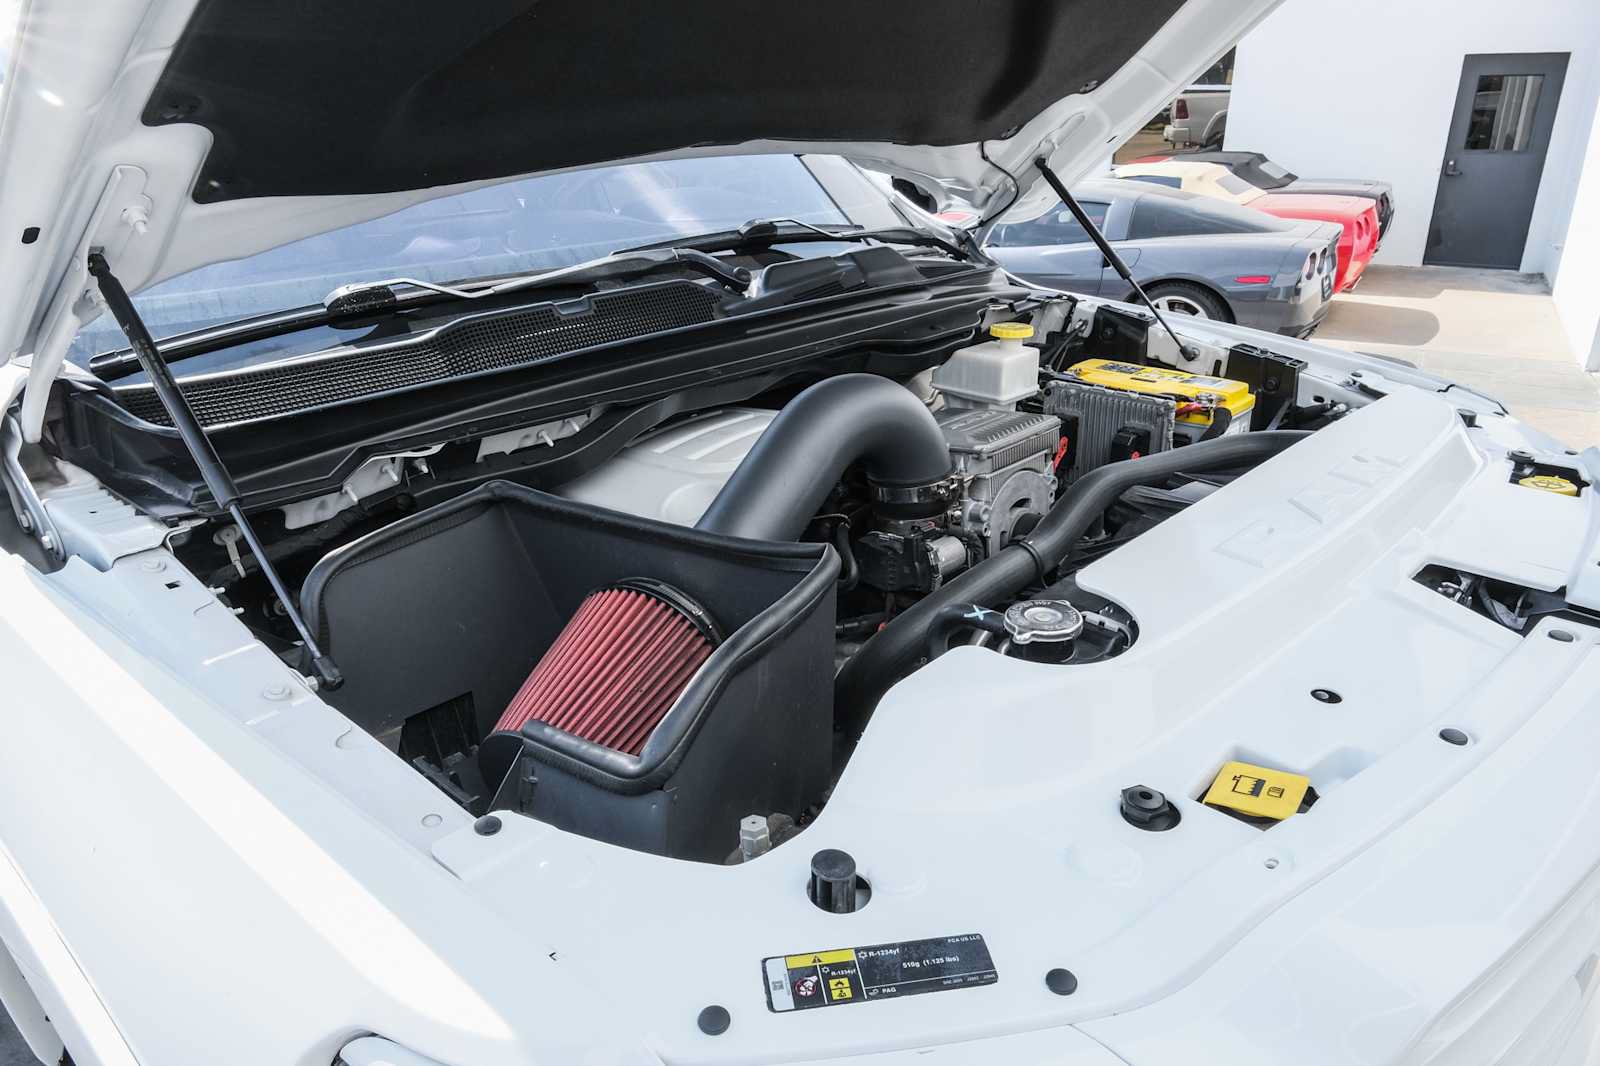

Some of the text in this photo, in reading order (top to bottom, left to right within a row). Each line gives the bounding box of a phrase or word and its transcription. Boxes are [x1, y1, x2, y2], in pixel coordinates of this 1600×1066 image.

[868, 947, 900, 958] R-1234yf
[922, 956, 945, 967] (1.125
[945, 955, 960, 963] lbs)
